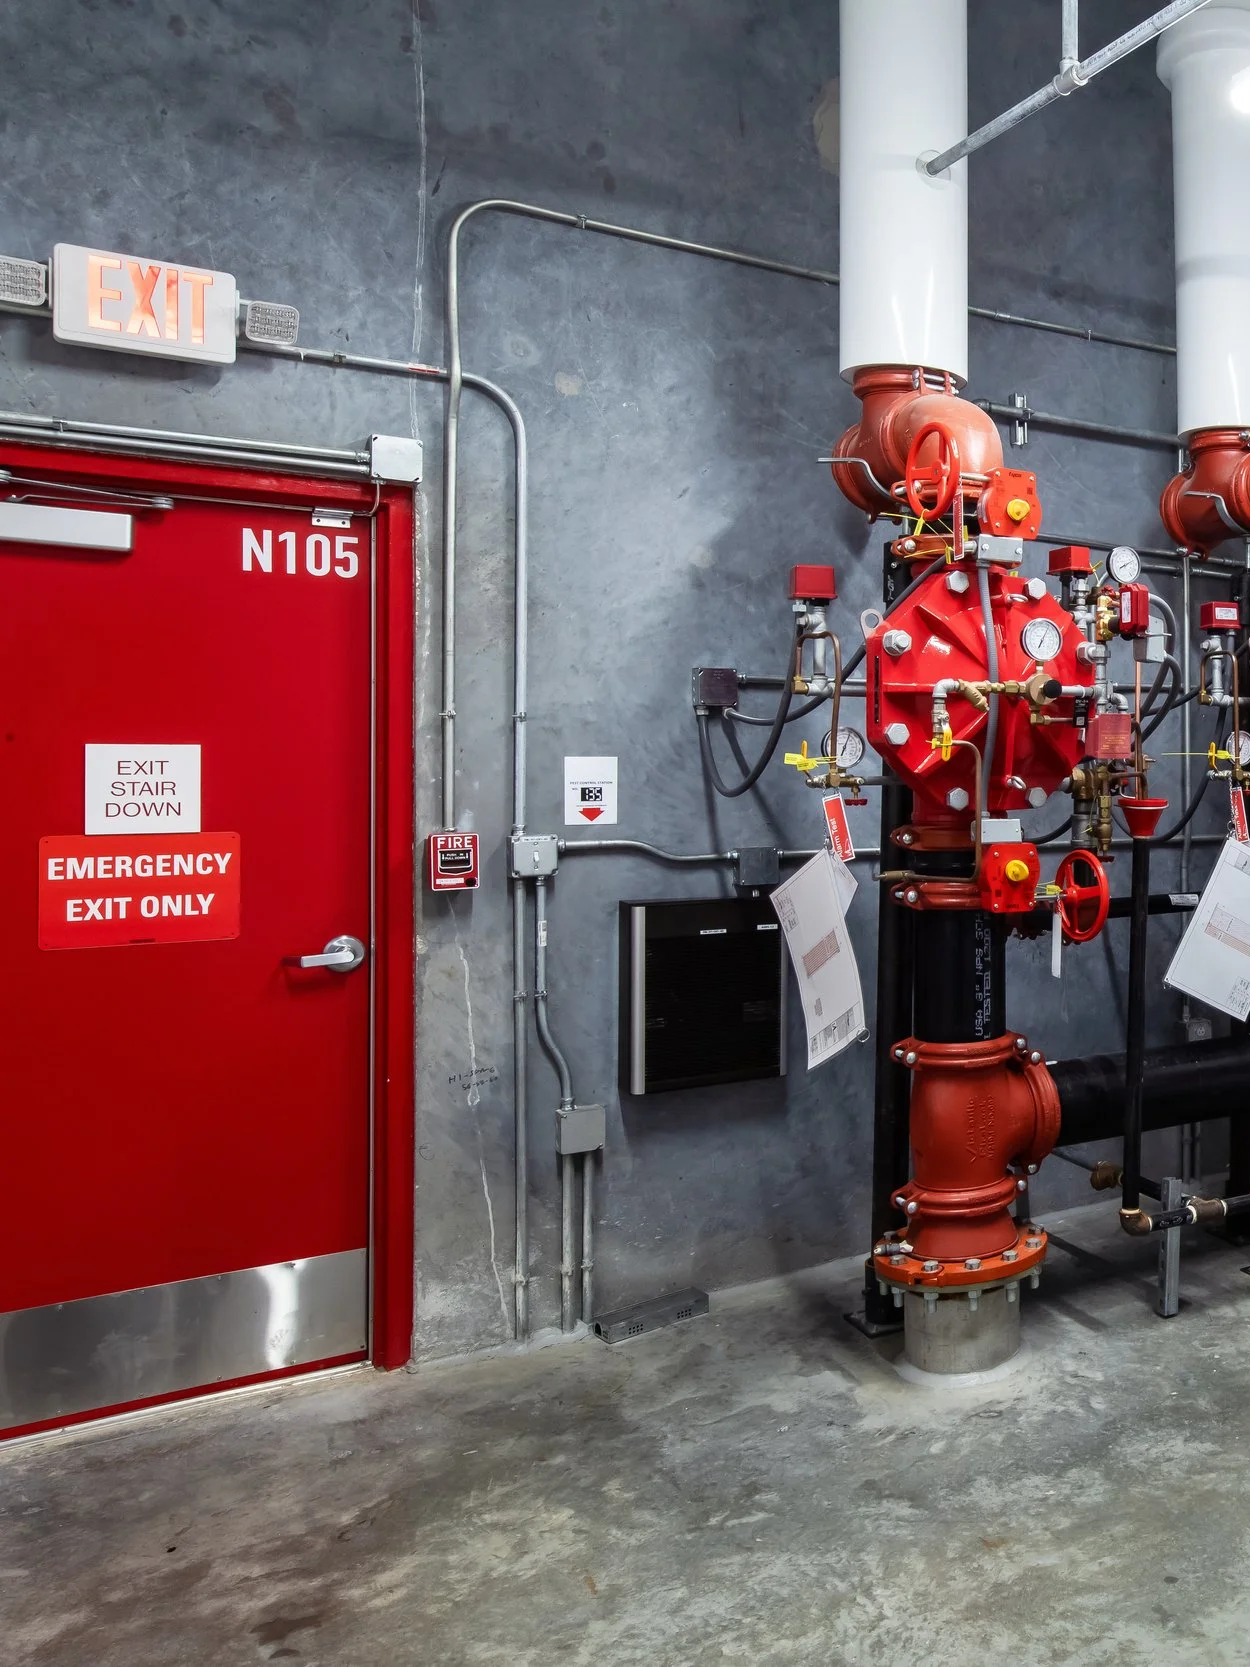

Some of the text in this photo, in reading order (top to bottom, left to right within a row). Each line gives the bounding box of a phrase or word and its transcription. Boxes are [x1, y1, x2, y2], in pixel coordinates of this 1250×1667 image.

[87, 253, 214, 345] EXIT
[241, 527, 360, 579] N105
[117, 760, 170, 776] EXIT
[110, 781, 177, 797] STAIR
[585, 787, 602, 801] 135
[105, 802, 182, 818] DOWN
[437, 835, 473, 849] FIRE
[47, 852, 233, 881] EMERGENCY
[66, 893, 216, 922] EXIT ONLY
[983, 970, 991, 1024] TESTED
[975, 1009, 984, 1036] USA
